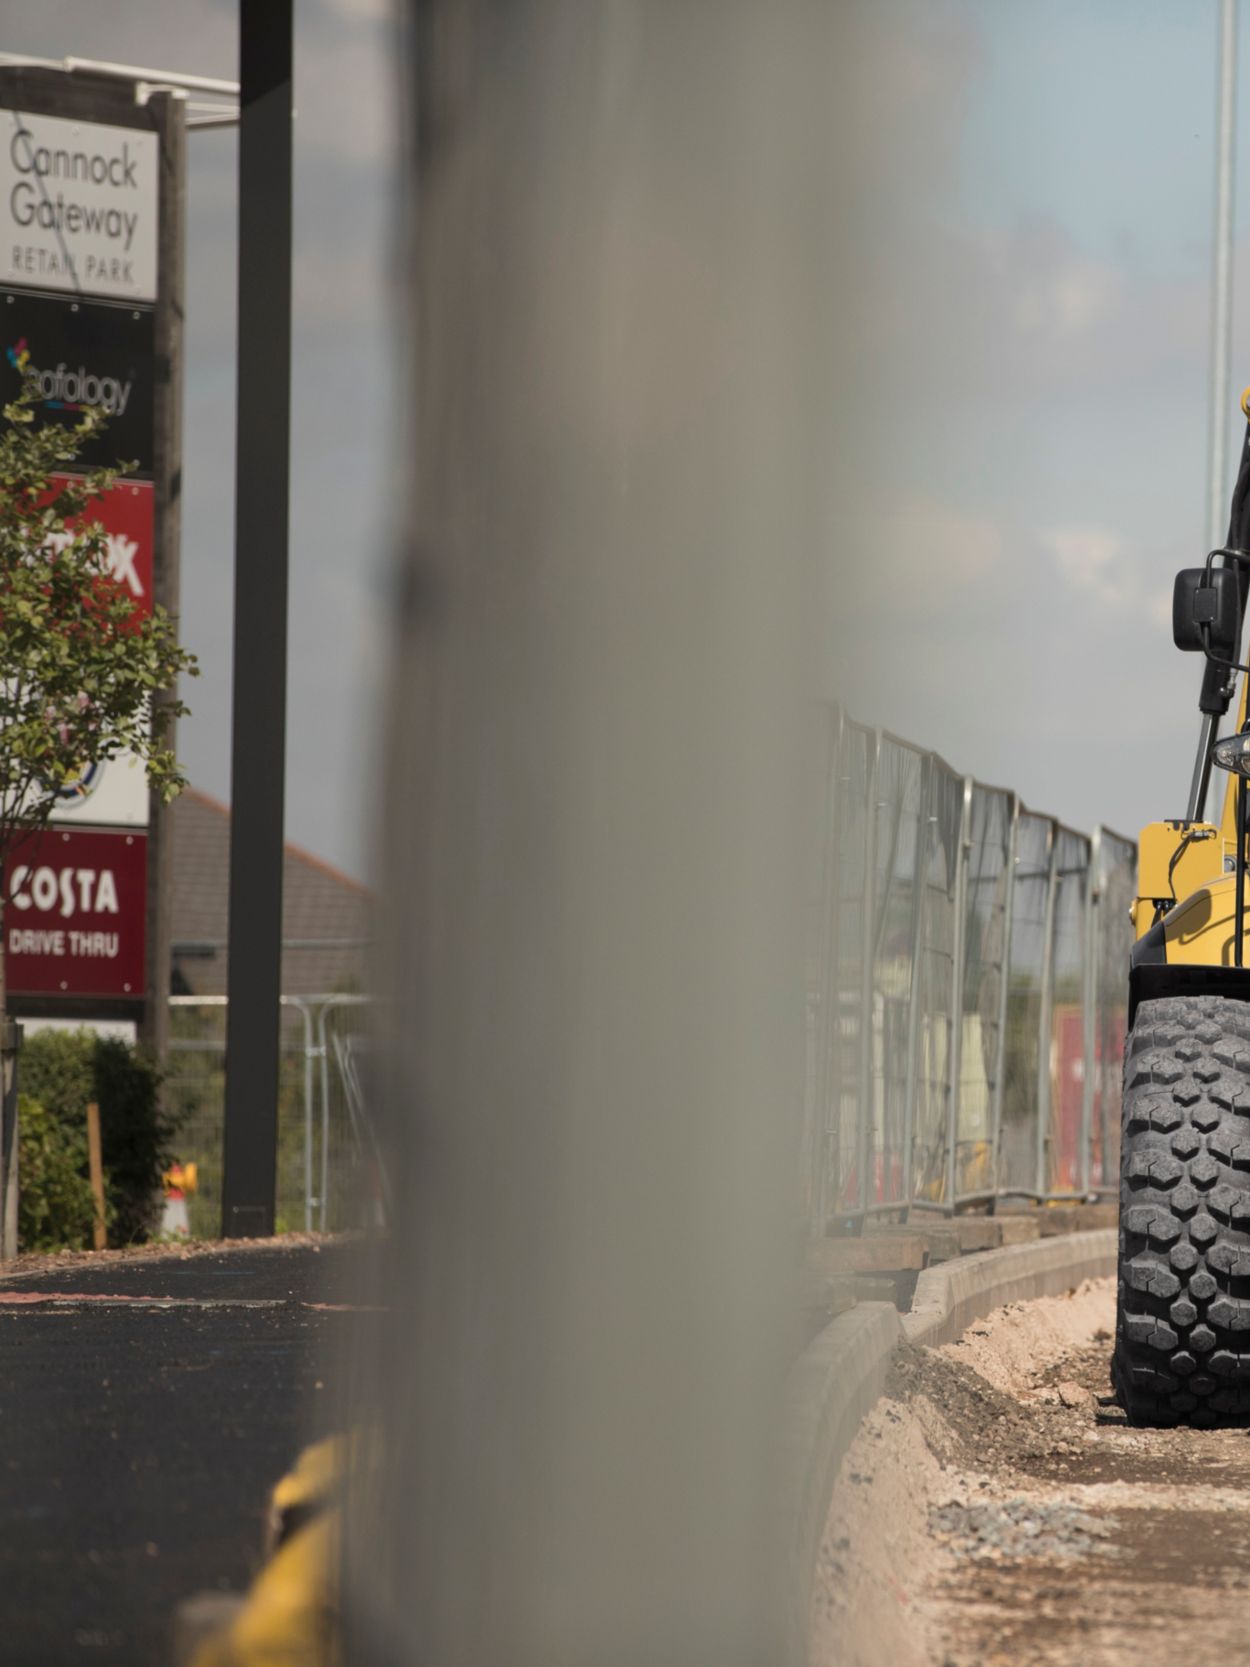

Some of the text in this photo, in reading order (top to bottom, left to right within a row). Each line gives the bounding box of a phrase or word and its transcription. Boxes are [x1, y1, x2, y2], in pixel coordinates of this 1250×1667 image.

[10, 128, 138, 189] Cannock
[10, 181, 138, 253] Gateway
[86, 254, 134, 282] PARK
[10, 865, 119, 918] COSTA
[9, 928, 119, 958] DRIVE THRU
